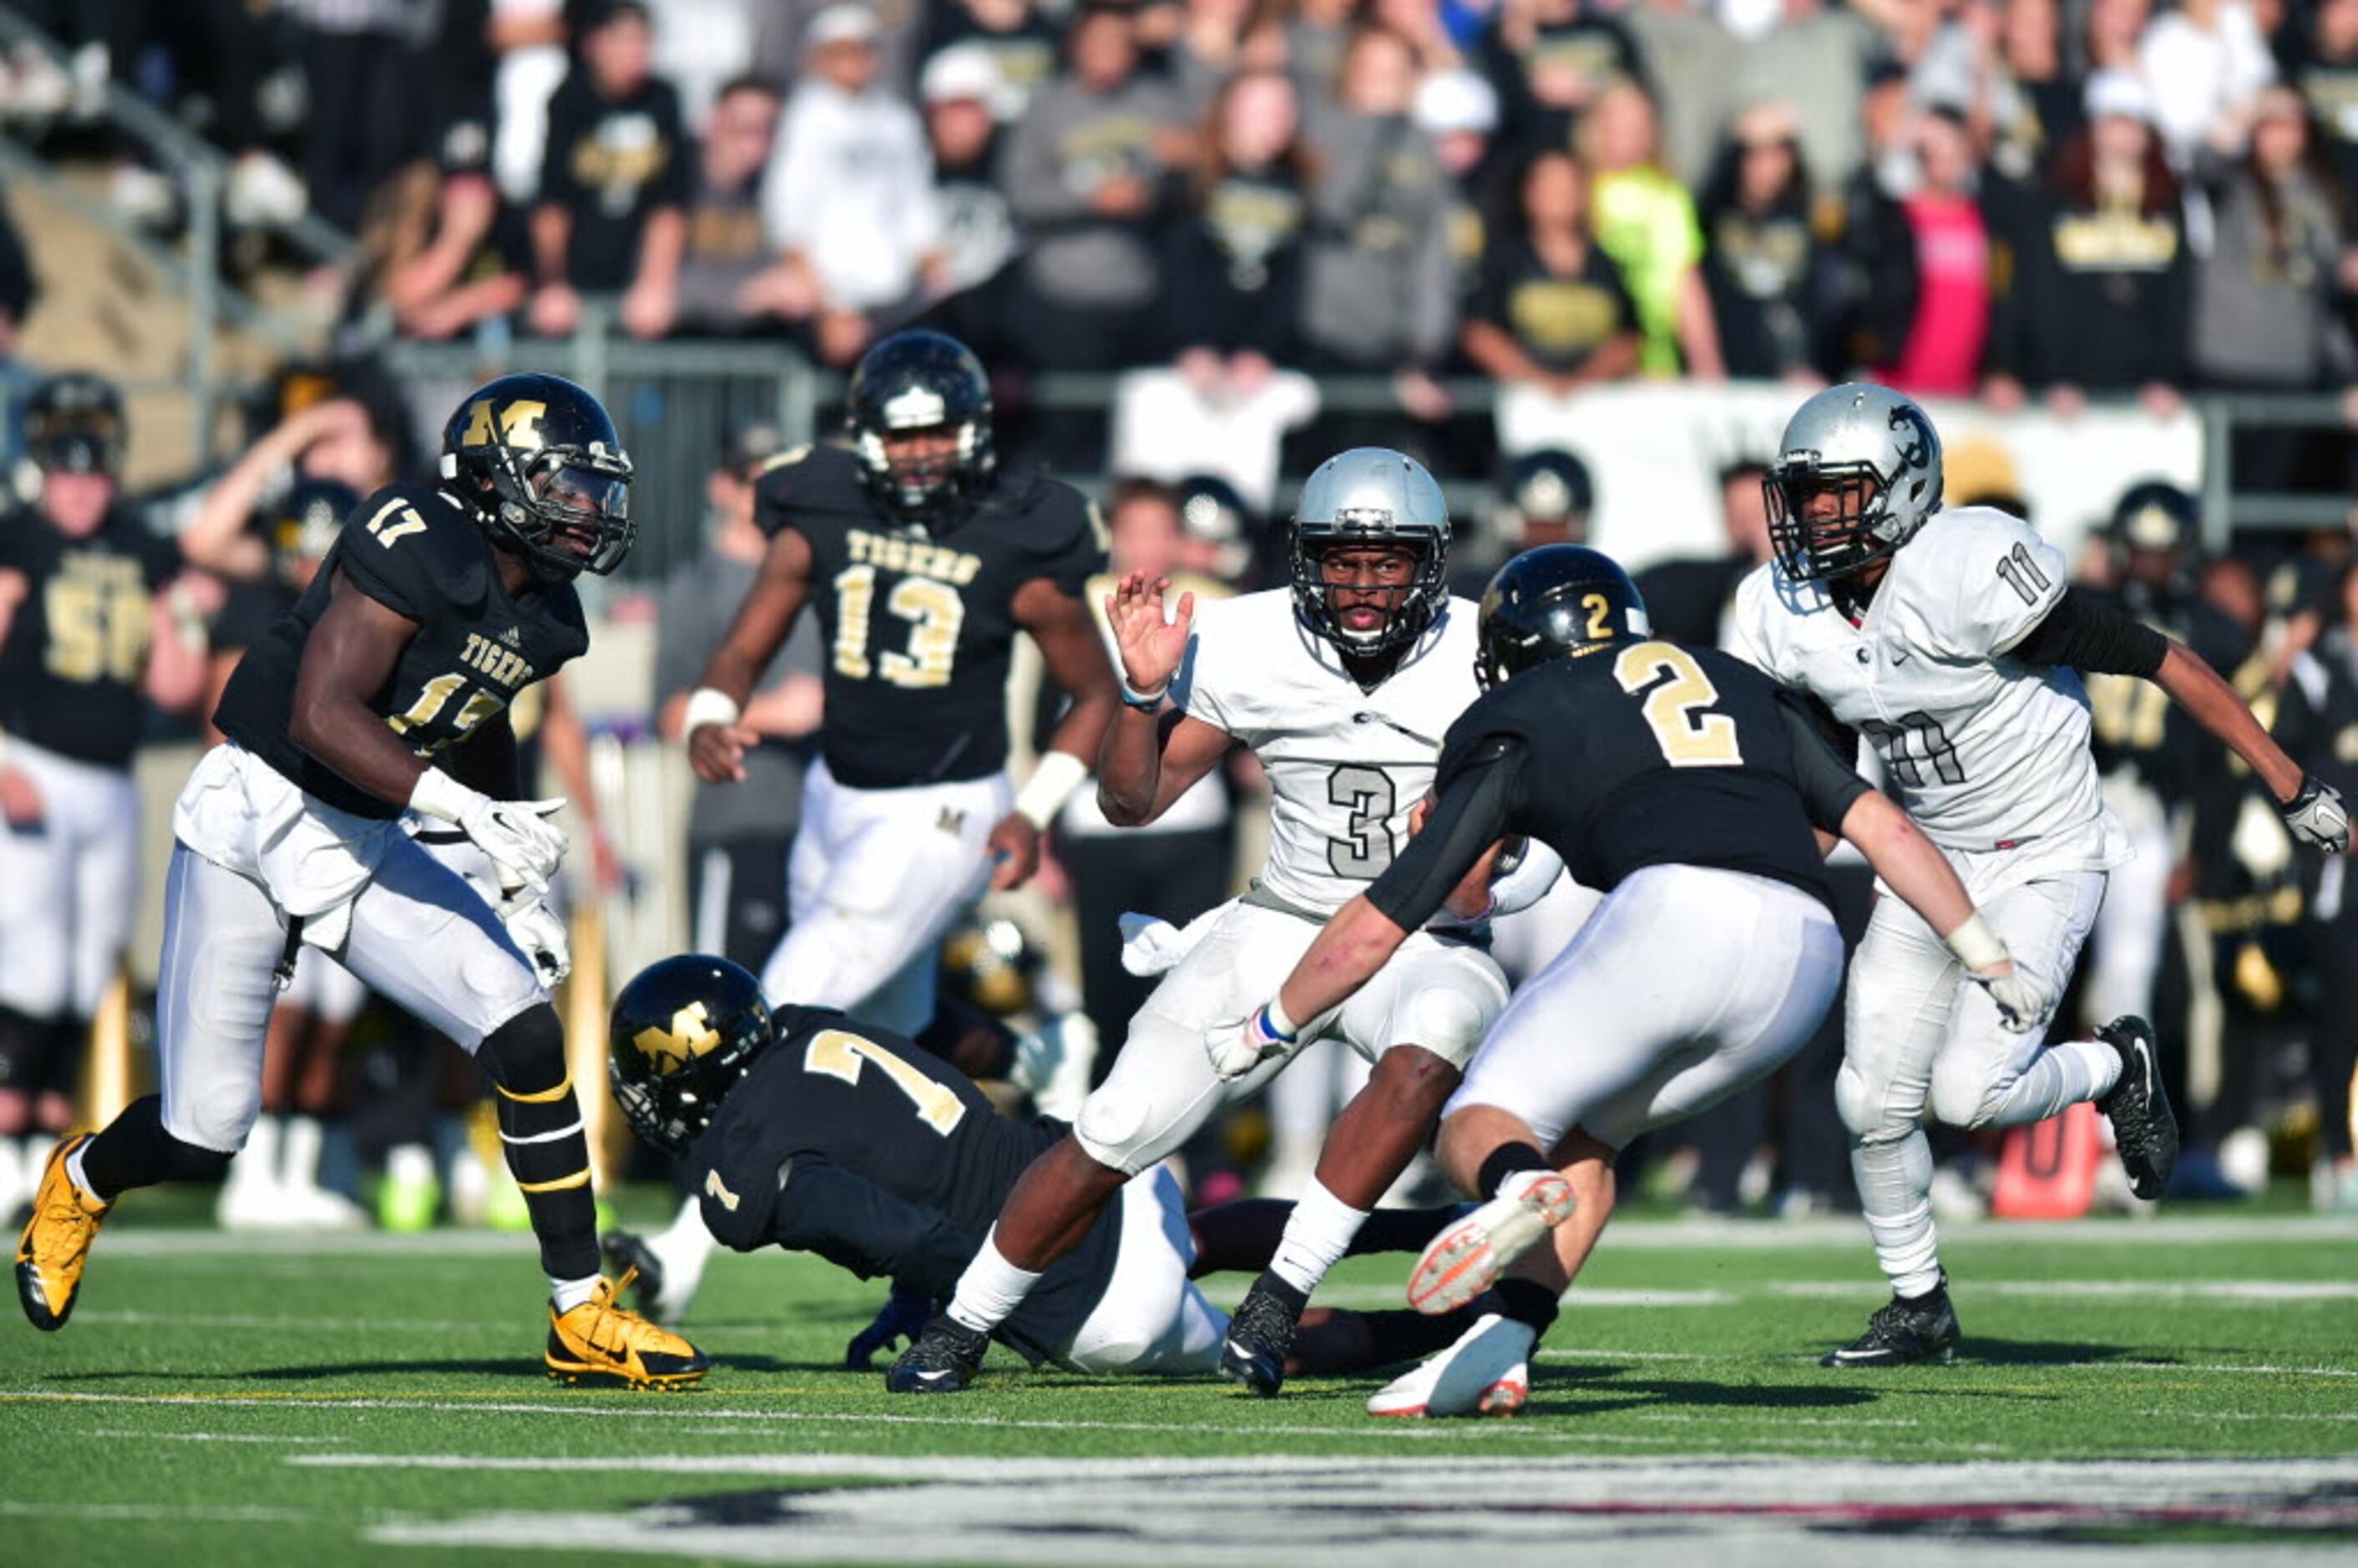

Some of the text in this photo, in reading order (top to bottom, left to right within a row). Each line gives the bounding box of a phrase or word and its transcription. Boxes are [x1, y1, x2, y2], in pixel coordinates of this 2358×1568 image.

[366, 496, 427, 549] 17
[846, 529, 982, 584] TIGERS
[1996, 541, 2051, 606] 11
[833, 564, 964, 689] 13
[1581, 593, 1613, 639] 2
[1612, 641, 1744, 767] 2
[1860, 711, 1966, 787] 11
[1328, 762, 1396, 879] 3
[803, 1029, 966, 1137] 7
[705, 1167, 740, 1211] 7
